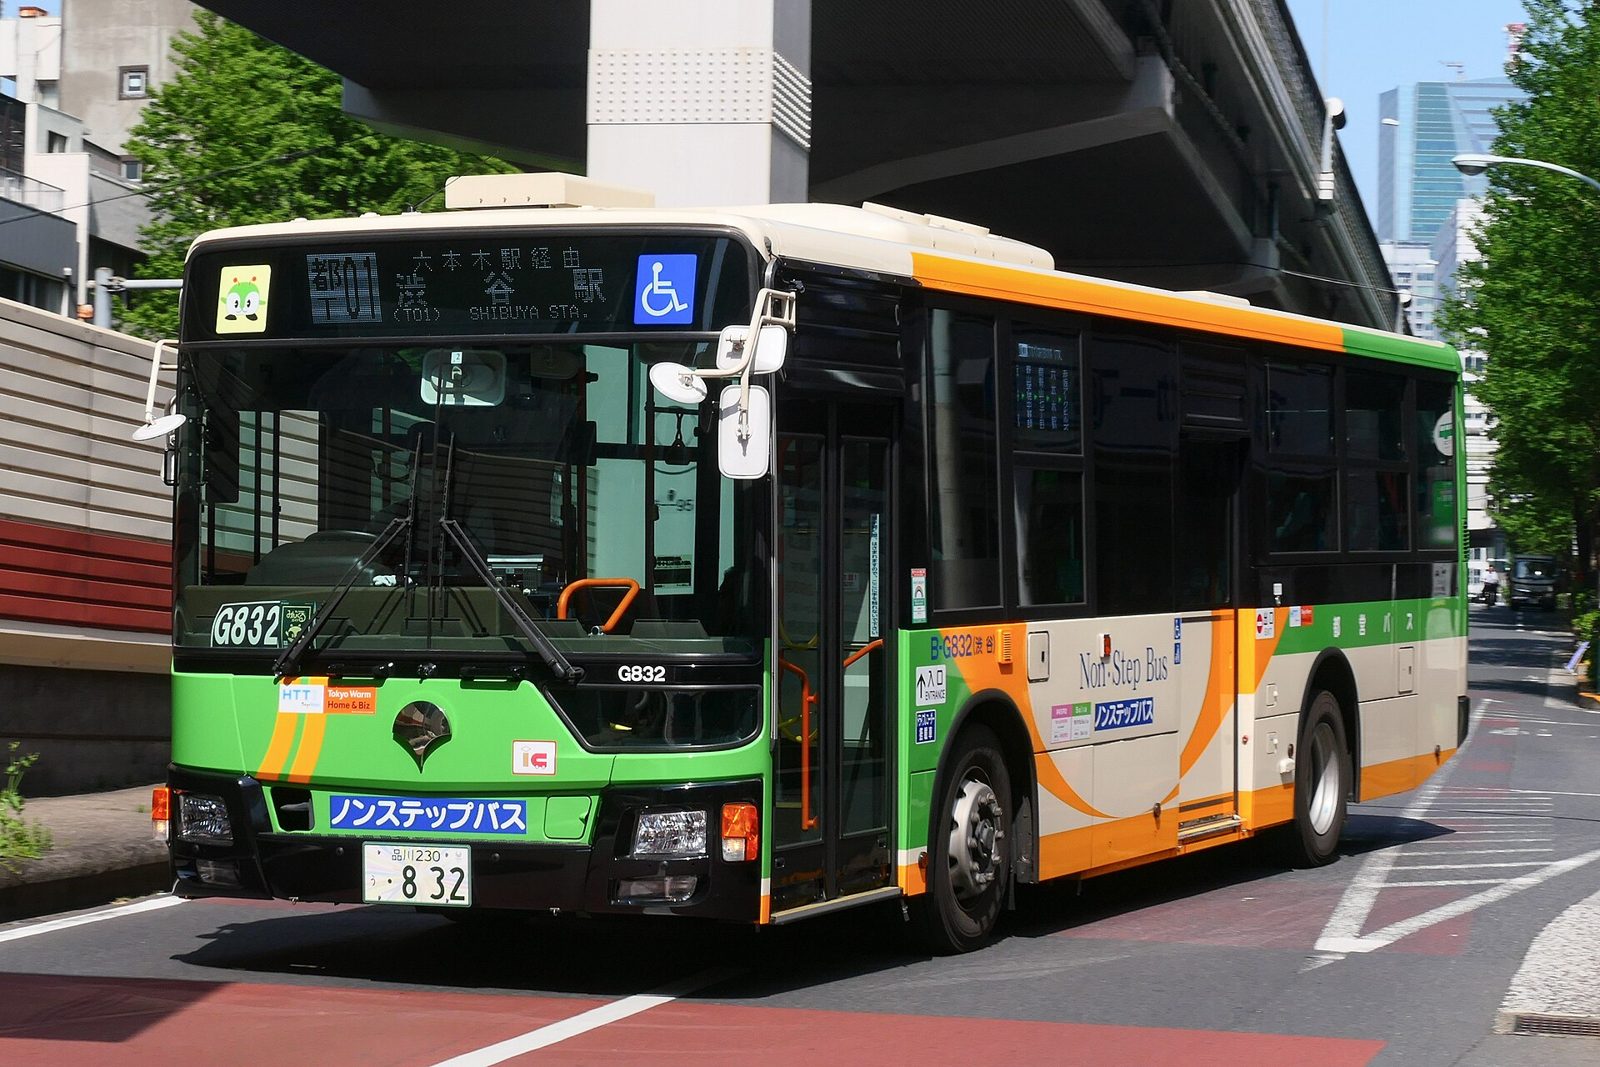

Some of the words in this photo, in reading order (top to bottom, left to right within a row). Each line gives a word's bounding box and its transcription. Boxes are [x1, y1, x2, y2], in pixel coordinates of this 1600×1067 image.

[412, 247, 580, 272] 六本木駅経由
[469, 305, 540, 321] SHIBUYA
[549, 304, 588, 319] STA.
[213, 605, 280, 646] G832
[618, 665, 666, 682] G832
[1146, 647, 1168, 682] Bus
[327, 689, 349, 700] Tokyo
[349, 690, 372, 698] Warm
[327, 701, 350, 709] Home
[351, 701, 358, 709] &
[358, 701, 370, 709] Biz
[1095, 700, 1153, 728] ノンステップバス
[330, 798, 526, 830] ノンステップバス
